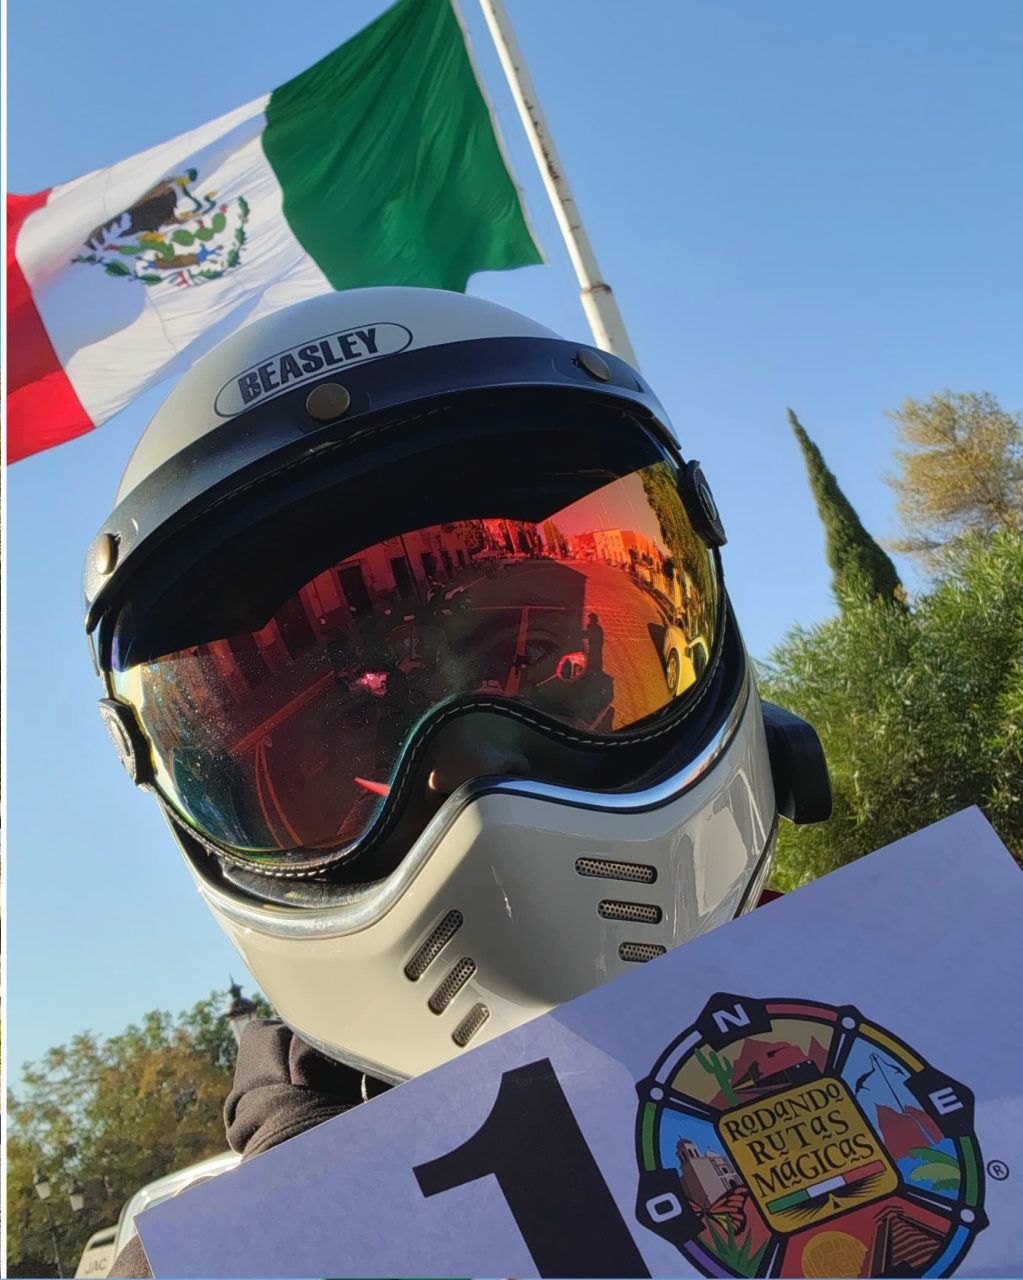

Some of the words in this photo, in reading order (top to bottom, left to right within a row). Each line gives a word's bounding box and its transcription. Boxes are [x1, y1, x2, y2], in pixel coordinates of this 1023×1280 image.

[237, 327, 379, 405] BEASLEY
[711, 1003, 751, 1034] N
[928, 1086, 965, 1115] E
[645, 1192, 682, 1223] O
